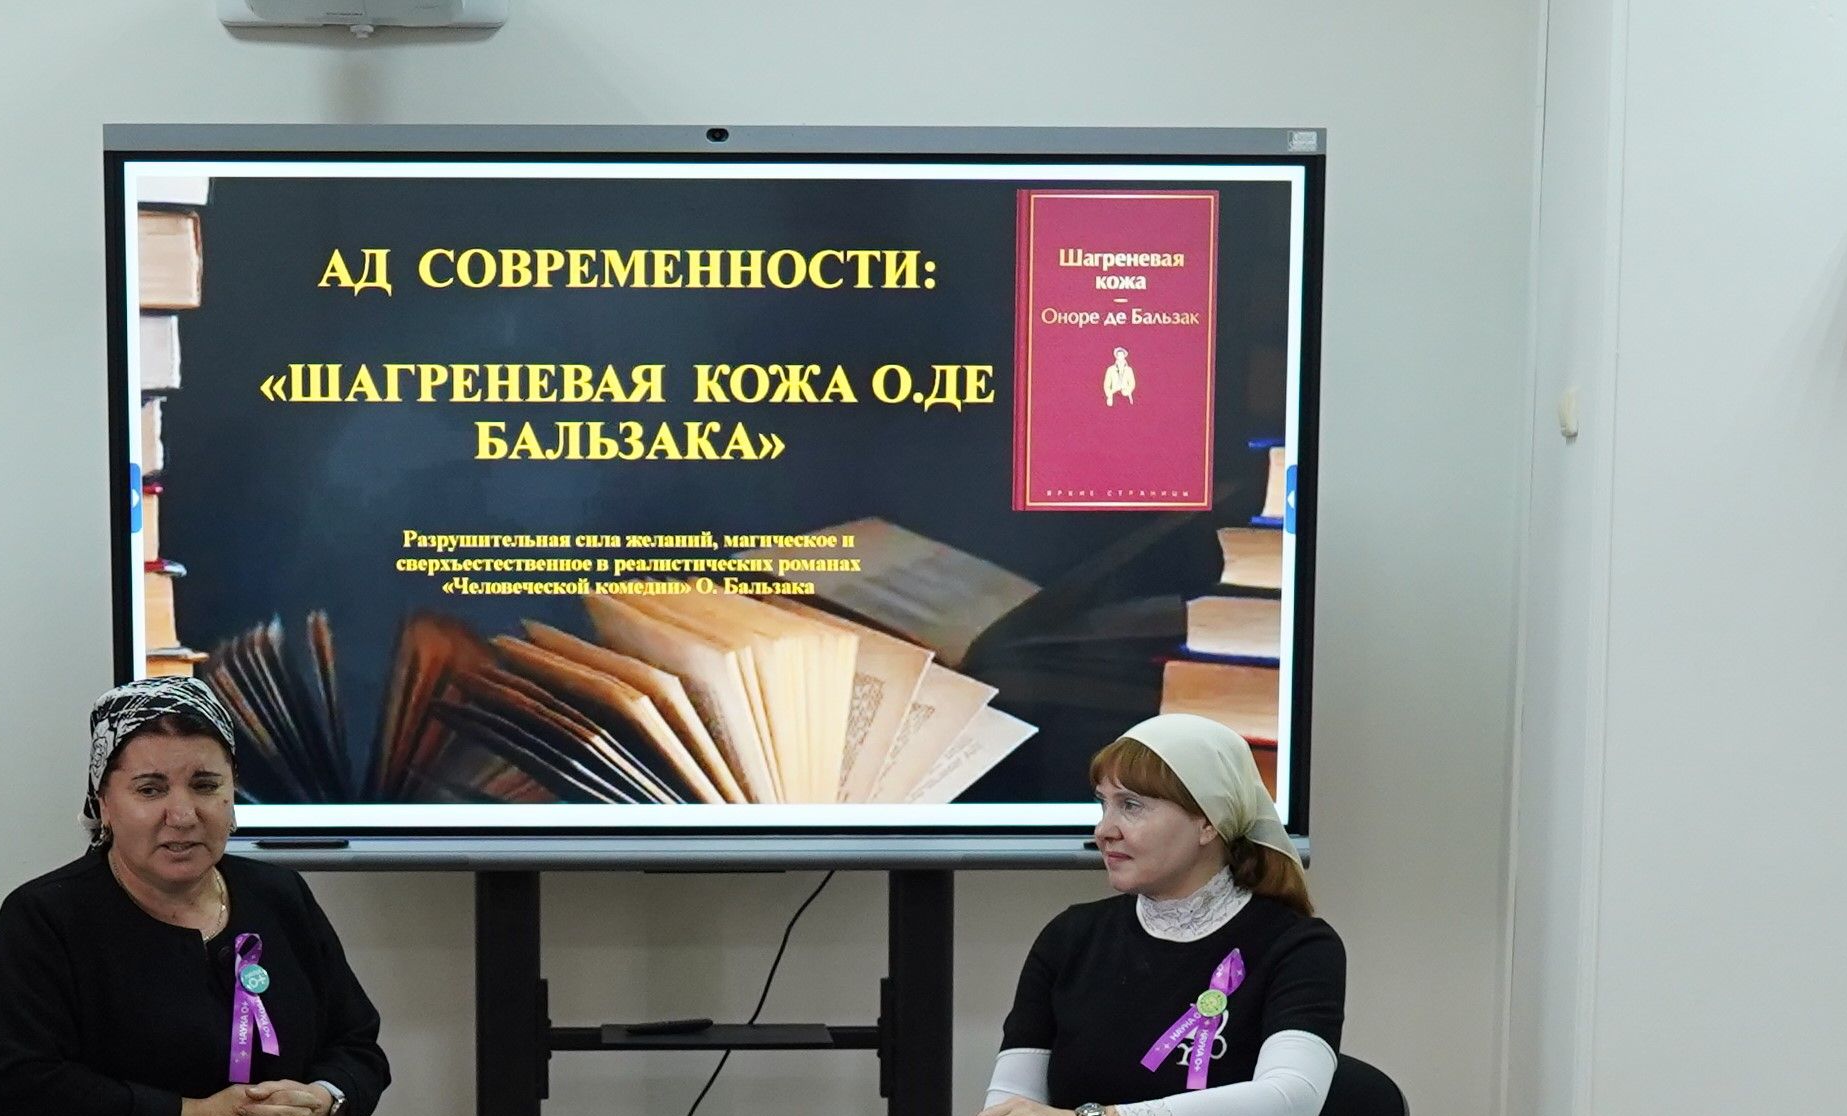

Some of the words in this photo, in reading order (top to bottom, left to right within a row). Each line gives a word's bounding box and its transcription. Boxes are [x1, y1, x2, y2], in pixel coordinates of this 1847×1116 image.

[1059, 248, 1185, 271] Шагреневая
[318, 249, 392, 294] АД
[417, 248, 937, 289] СОВРЕМЕННОСТИ:
[1095, 275, 1147, 290] кожа
[1041, 308, 1100, 328] Оноре
[1103, 312, 1127, 326] де
[1131, 308, 1199, 325] Бальзак
[259, 363, 665, 403] «ШАГРЕНЕВАЯ
[693, 363, 858, 403] КОЖА
[872, 363, 996, 412] О.ДЕ
[474, 420, 786, 461] БАЛЬЗАКА»
[403, 530, 571, 552] Разрушительная
[575, 534, 621, 548] сила
[626, 531, 718, 550] желаний,
[724, 534, 837, 548] магическое
[842, 534, 855, 548] и
[396, 558, 592, 576] сверхъестественное
[597, 558, 609, 571] в
[614, 558, 773, 576] реалистических
[778, 558, 861, 576] романах
[442, 577, 590, 595] «Человеческой
[595, 580, 691, 596] комедии»
[696, 577, 717, 595] О.
[724, 577, 815, 595] Бальзака
